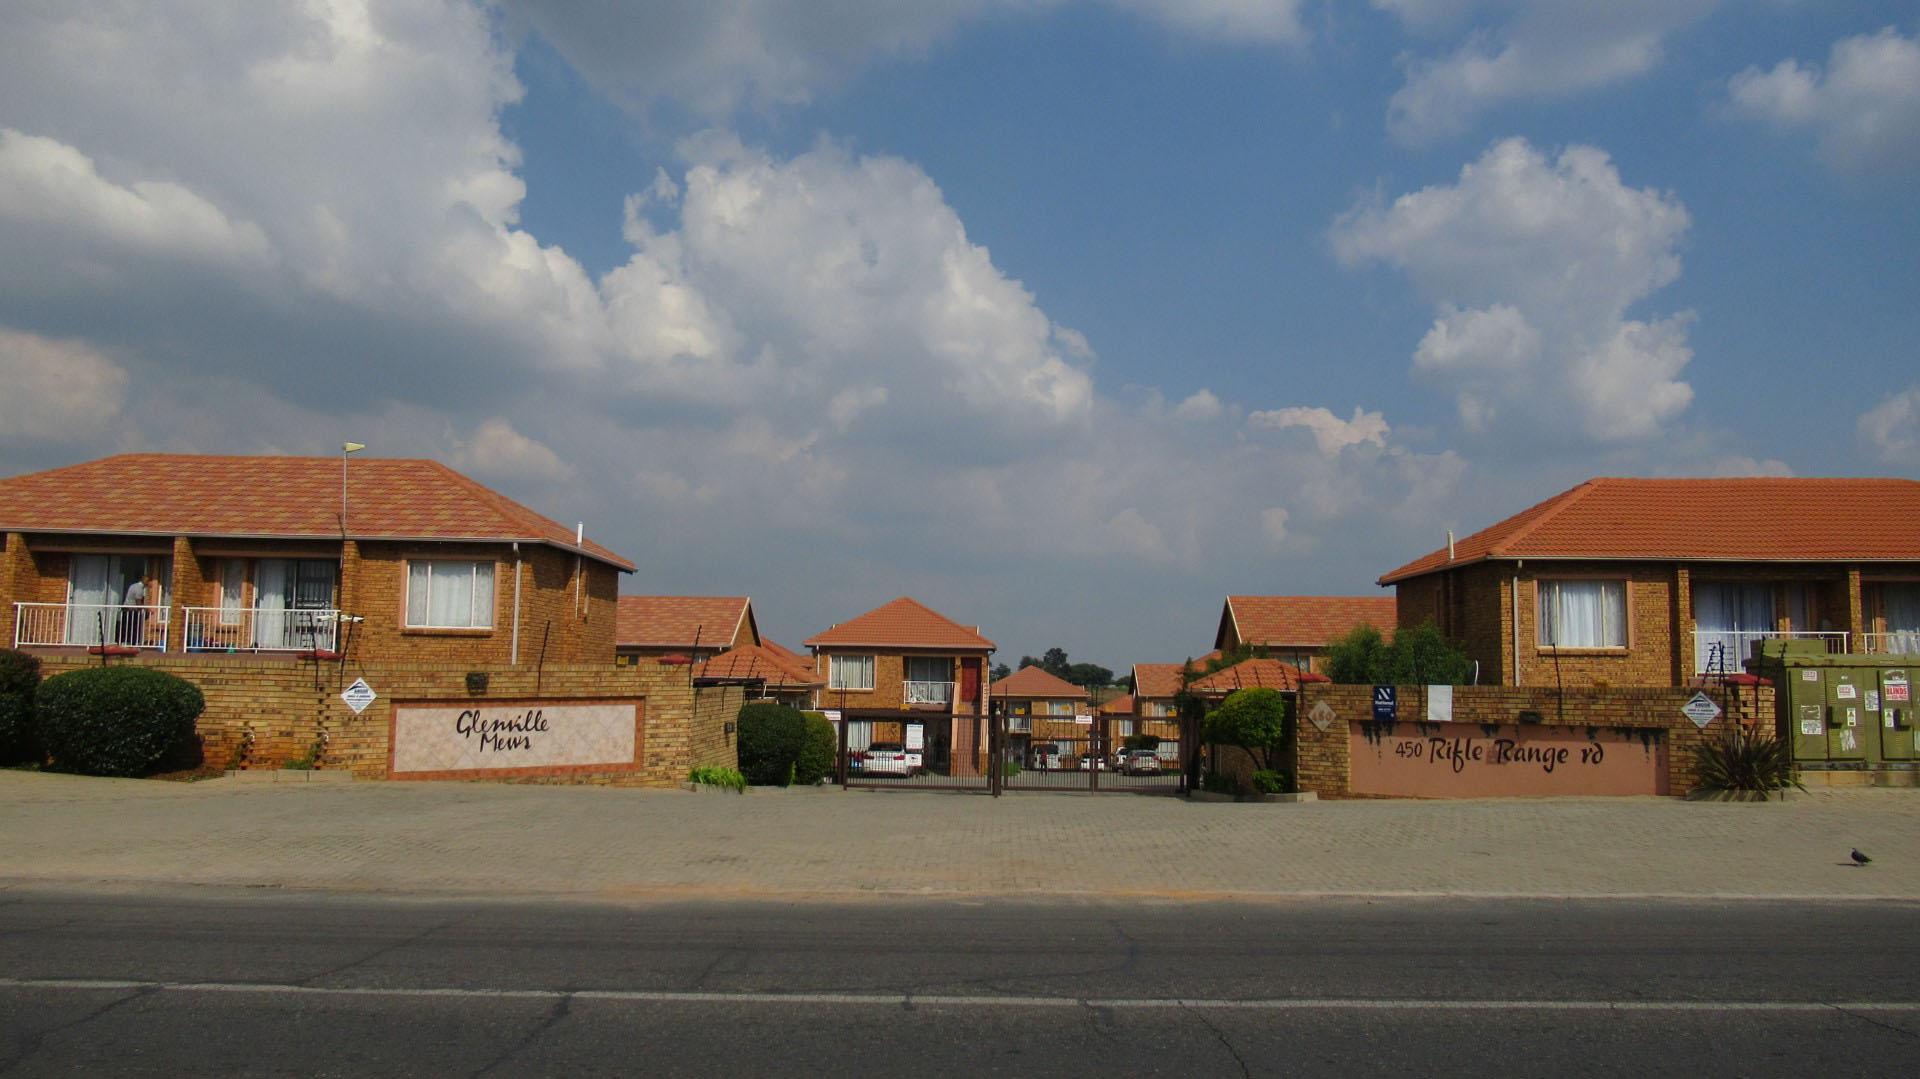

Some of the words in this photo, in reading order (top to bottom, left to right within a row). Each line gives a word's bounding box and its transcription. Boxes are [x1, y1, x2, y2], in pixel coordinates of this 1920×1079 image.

[456, 709, 549, 739] Glenville
[480, 732, 531, 753] Mews
[1395, 741, 1423, 758] 450
[1428, 737, 1483, 773] Rifle
[1494, 739, 1569, 773] Range
[1581, 742, 1604, 765] rd
